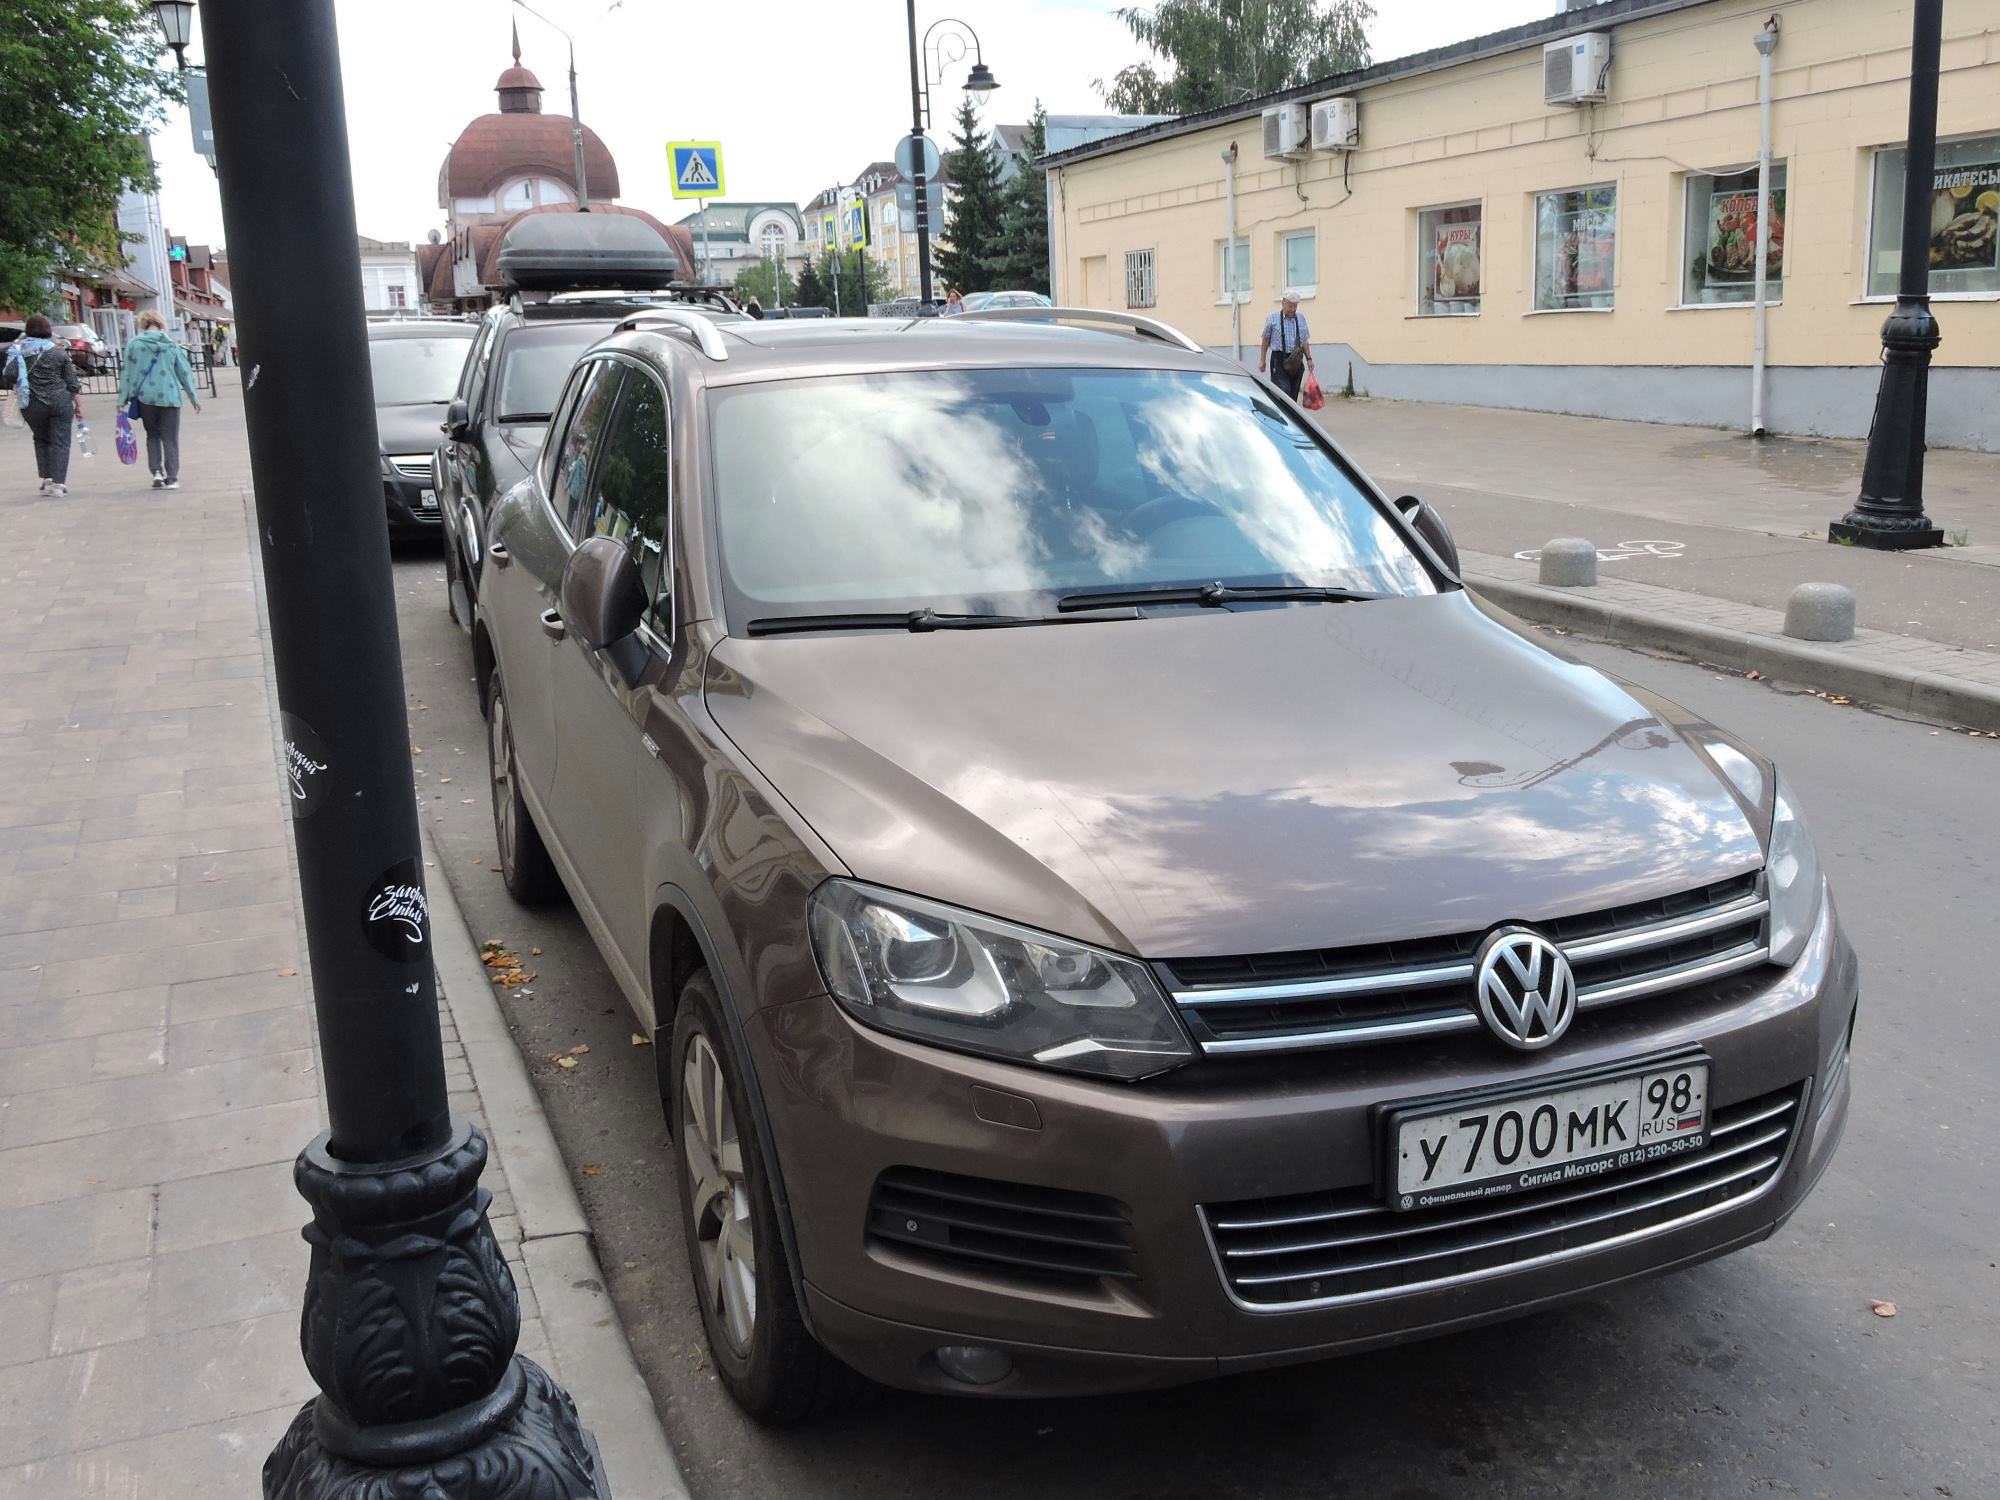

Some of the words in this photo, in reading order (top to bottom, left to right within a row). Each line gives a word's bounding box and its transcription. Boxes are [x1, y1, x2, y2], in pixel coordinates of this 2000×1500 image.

[1933, 169, 2000, 189] ИКАТЕСЫ
[1721, 195, 1775, 212] КОЛБАА
[1450, 229, 1472, 241] КУРЫ
[1647, 1073, 1692, 1120] 98
[1641, 1117, 1676, 1138] RUS
[1420, 1187, 1483, 1206] Официальный
[1485, 1183, 1512, 1196] дилер
[1519, 1169, 1561, 1188] Сигма
[1564, 1156, 1614, 1179] Моторс
[1618, 1148, 1646, 1168] (812)
[1647, 1134, 1703, 1159] 320-50-50
